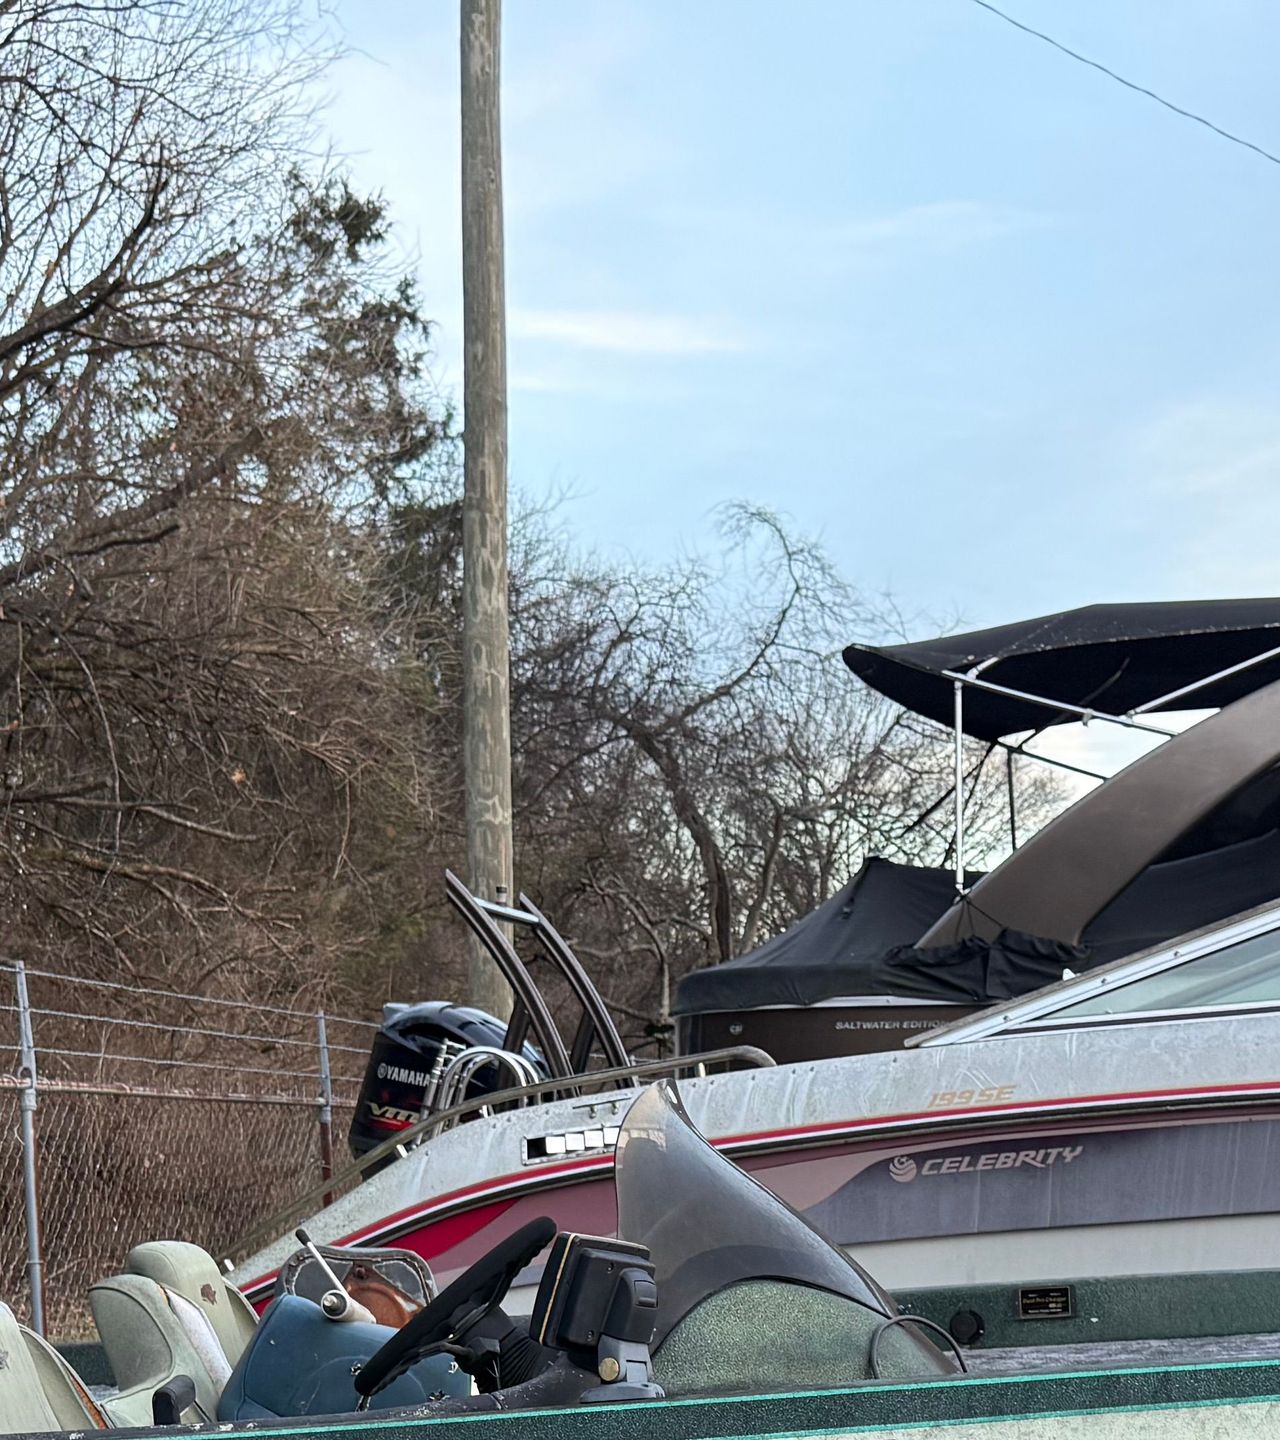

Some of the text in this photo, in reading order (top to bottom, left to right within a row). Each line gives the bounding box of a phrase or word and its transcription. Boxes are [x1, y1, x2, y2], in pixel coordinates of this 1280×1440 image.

[835, 1020, 900, 1030] SALTWATER
[386, 1065, 431, 1087] YAMAHA
[928, 1085, 1017, 1109] 199 SE
[921, 1145, 1084, 1176] CELEBRITY
